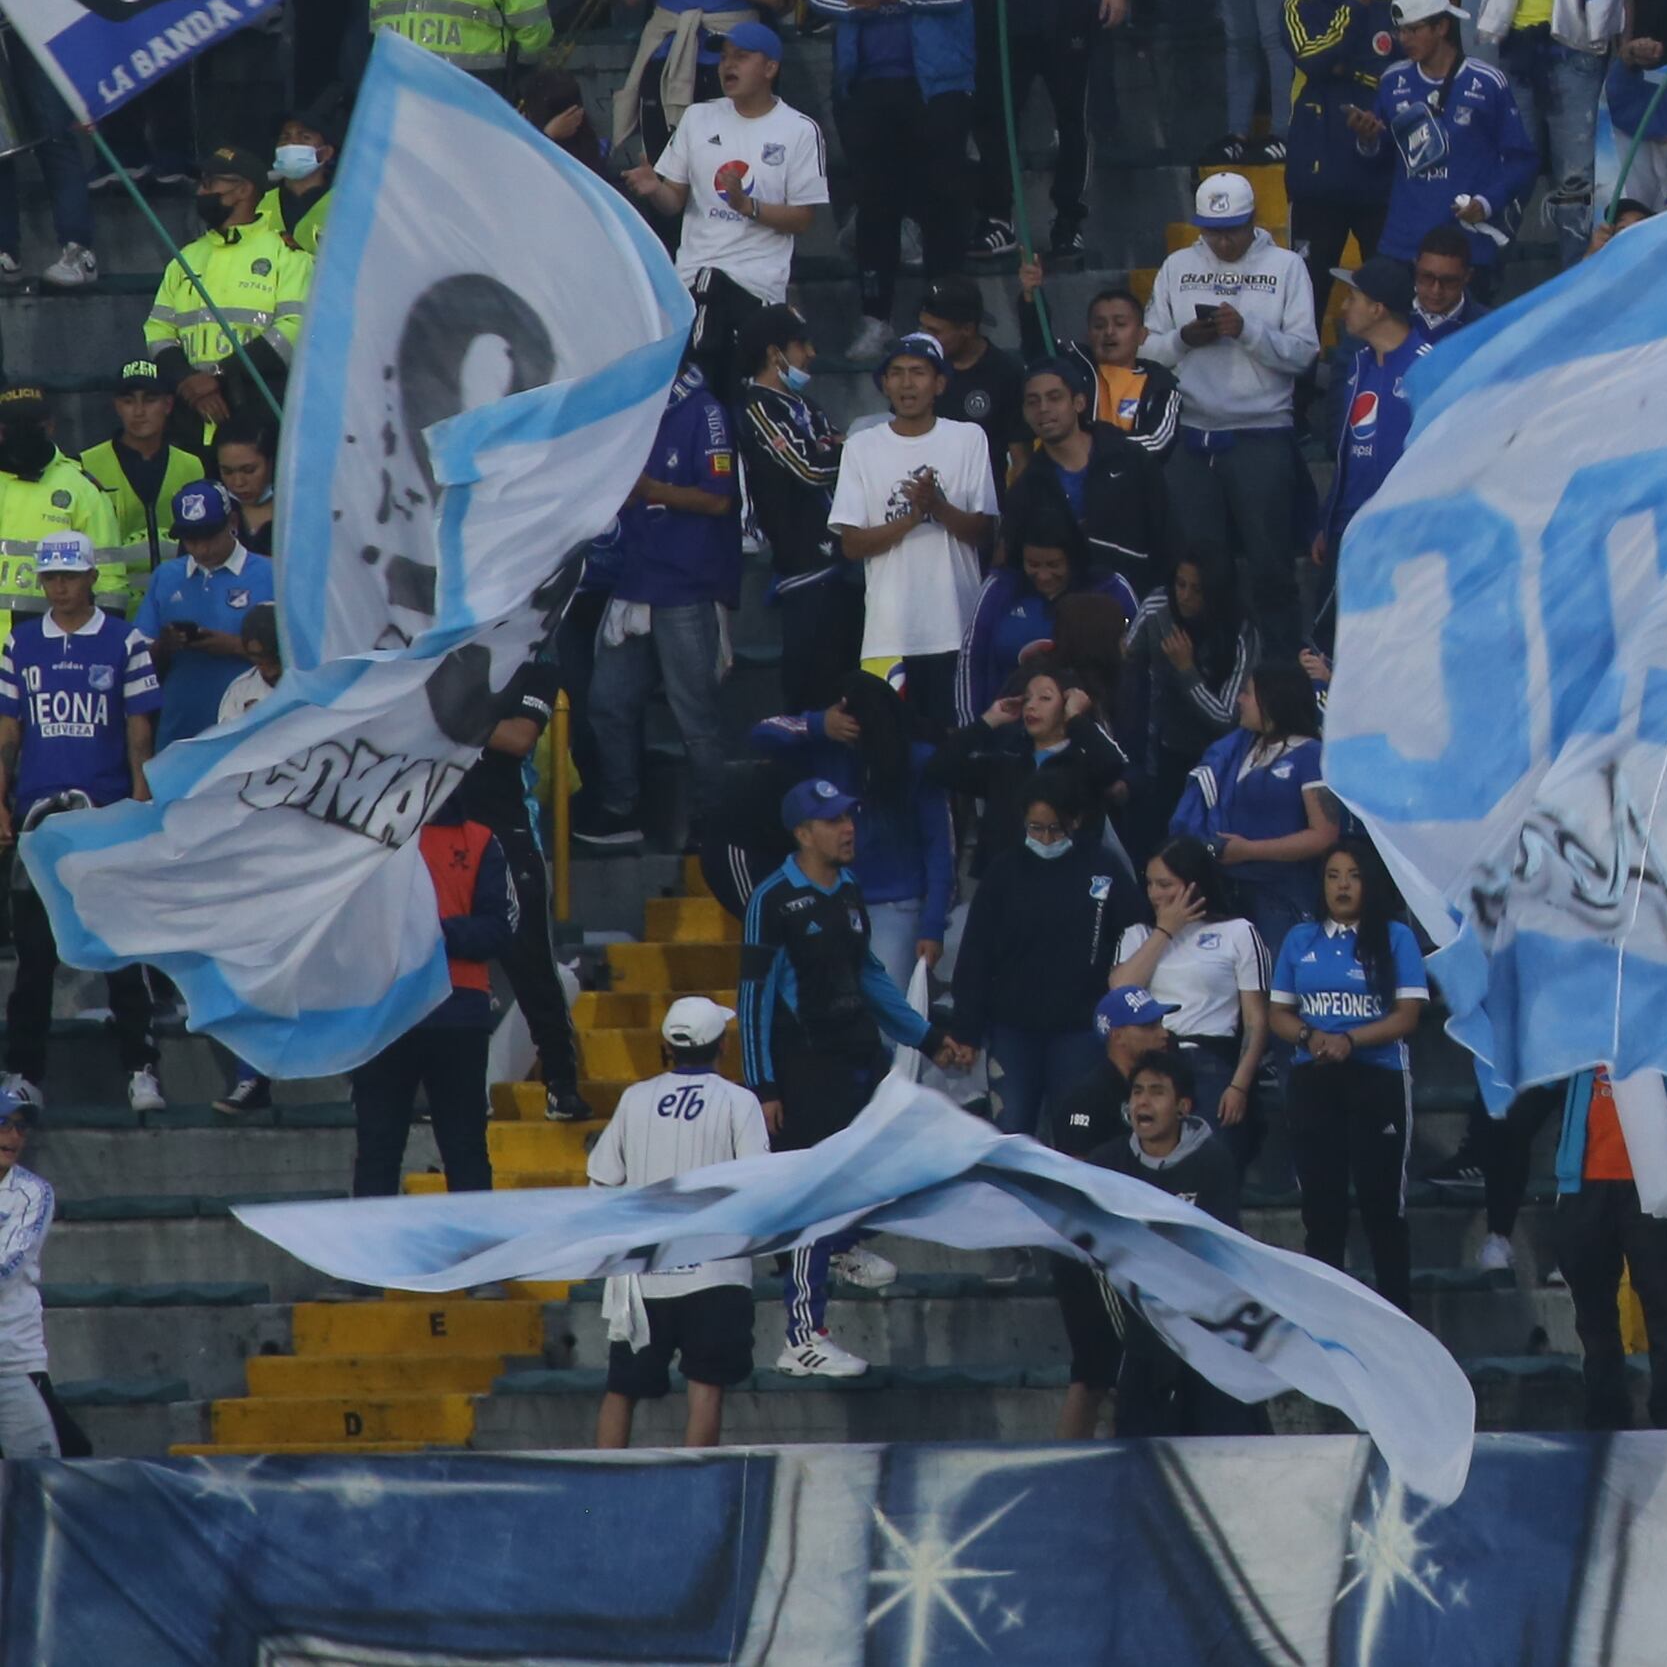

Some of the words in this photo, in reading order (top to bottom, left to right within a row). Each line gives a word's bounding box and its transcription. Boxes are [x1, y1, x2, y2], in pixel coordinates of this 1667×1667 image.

[97, 64, 136, 105] LA
[22, 664, 42, 693] 10
[657, 1084, 706, 1122] eTb
[429, 1312, 448, 1337] E
[344, 1411, 364, 1438] D
